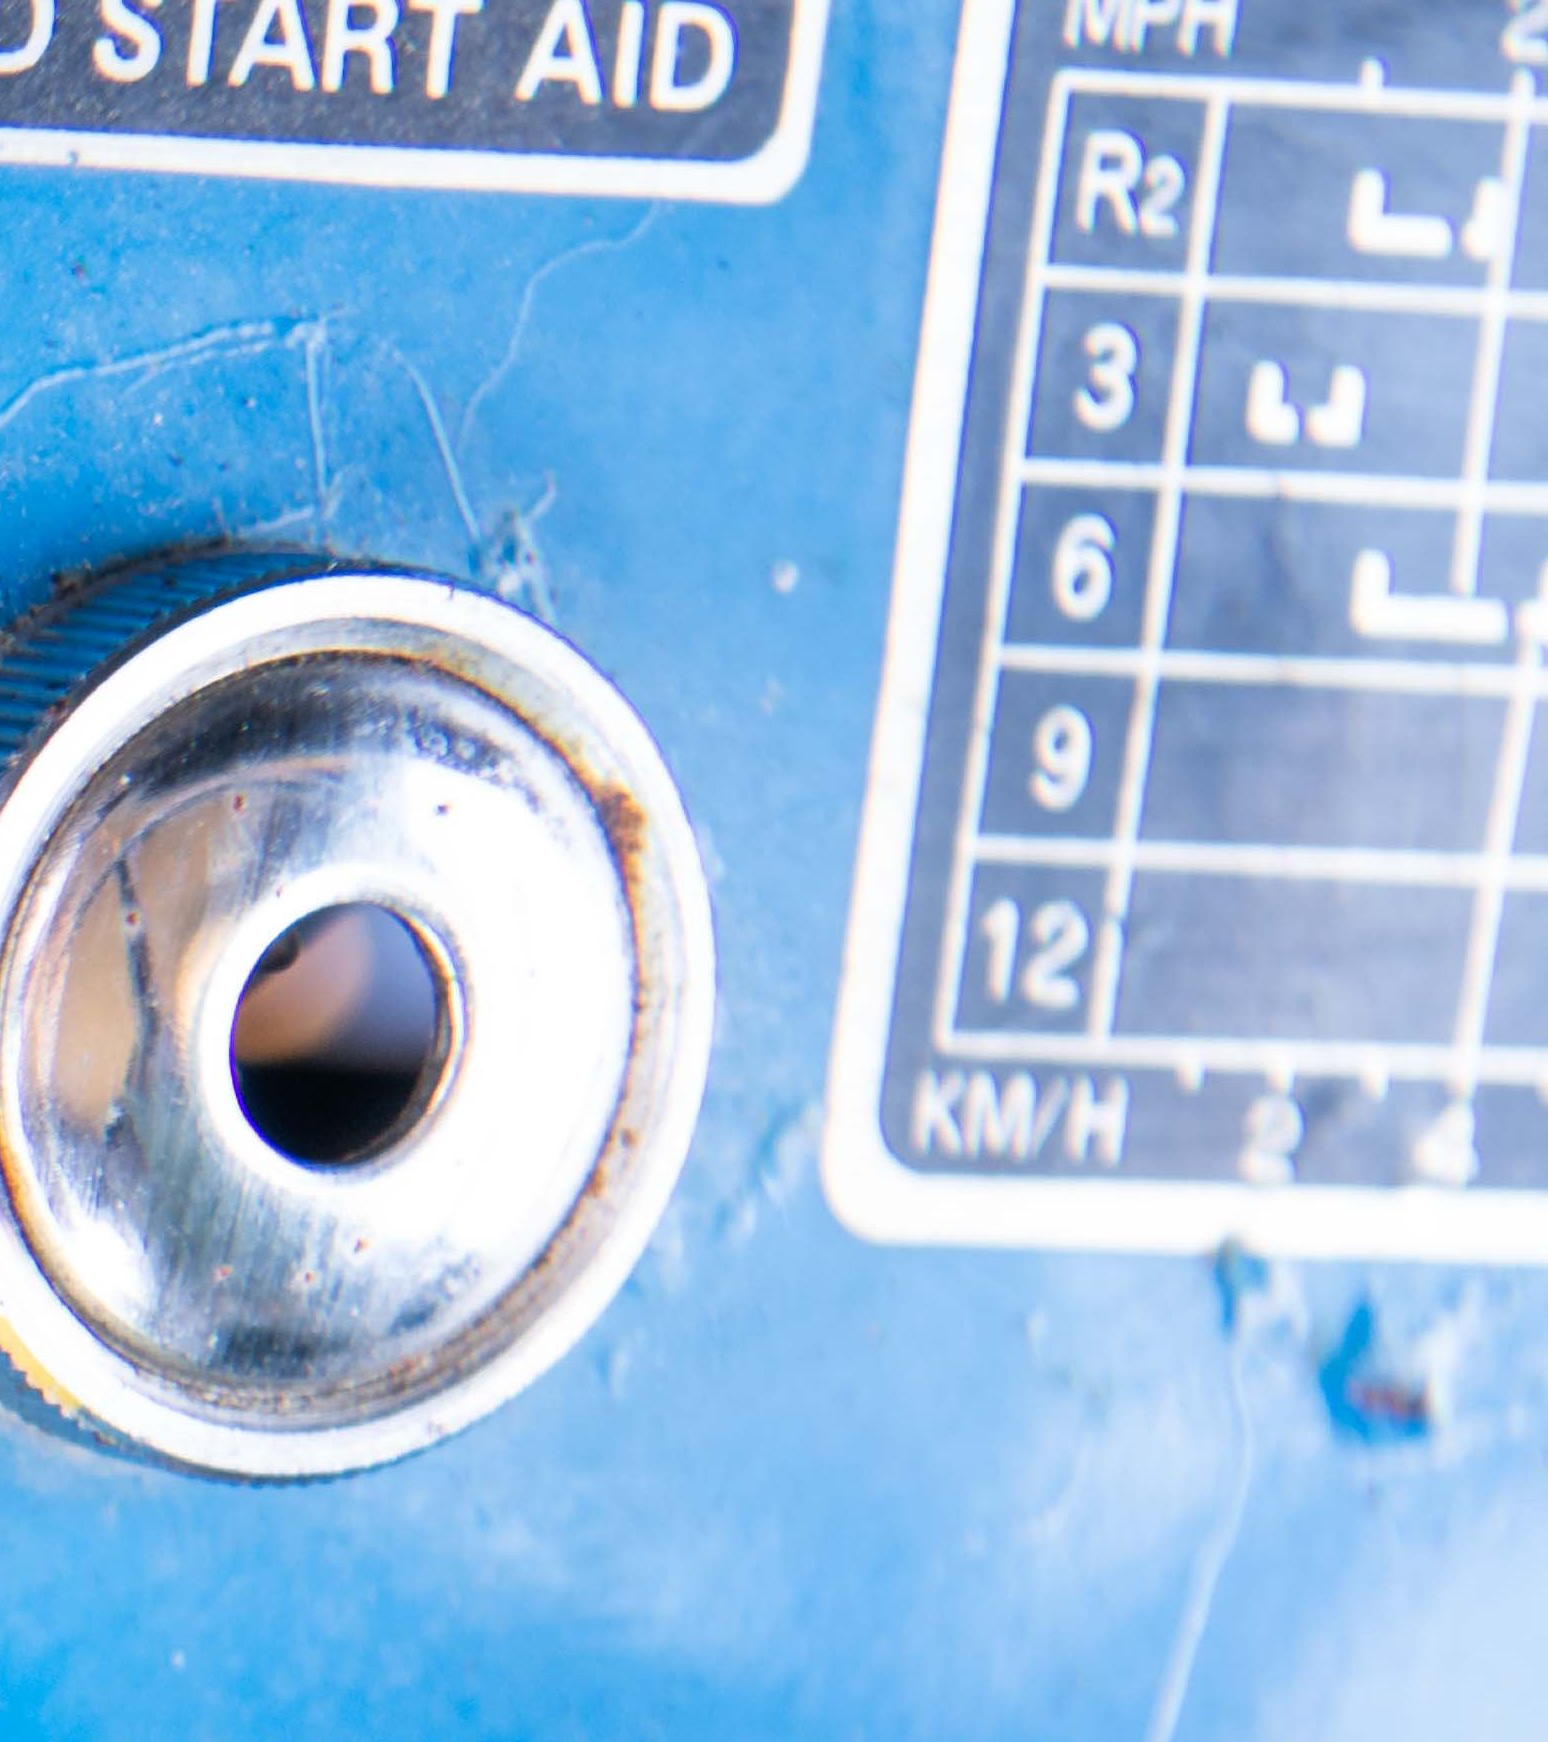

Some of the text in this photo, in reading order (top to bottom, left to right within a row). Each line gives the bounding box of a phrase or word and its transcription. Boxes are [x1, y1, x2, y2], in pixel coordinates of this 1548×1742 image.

[92, 0, 483, 100] START
[514, 0, 739, 110] AID
[1075, 129, 1188, 237] R2
[1073, 322, 1139, 431] 3
[1052, 512, 1115, 621] 6
[1029, 704, 1092, 812] 9
[980, 897, 1089, 1011] 12
[912, 1069, 1129, 1167] KM/H
